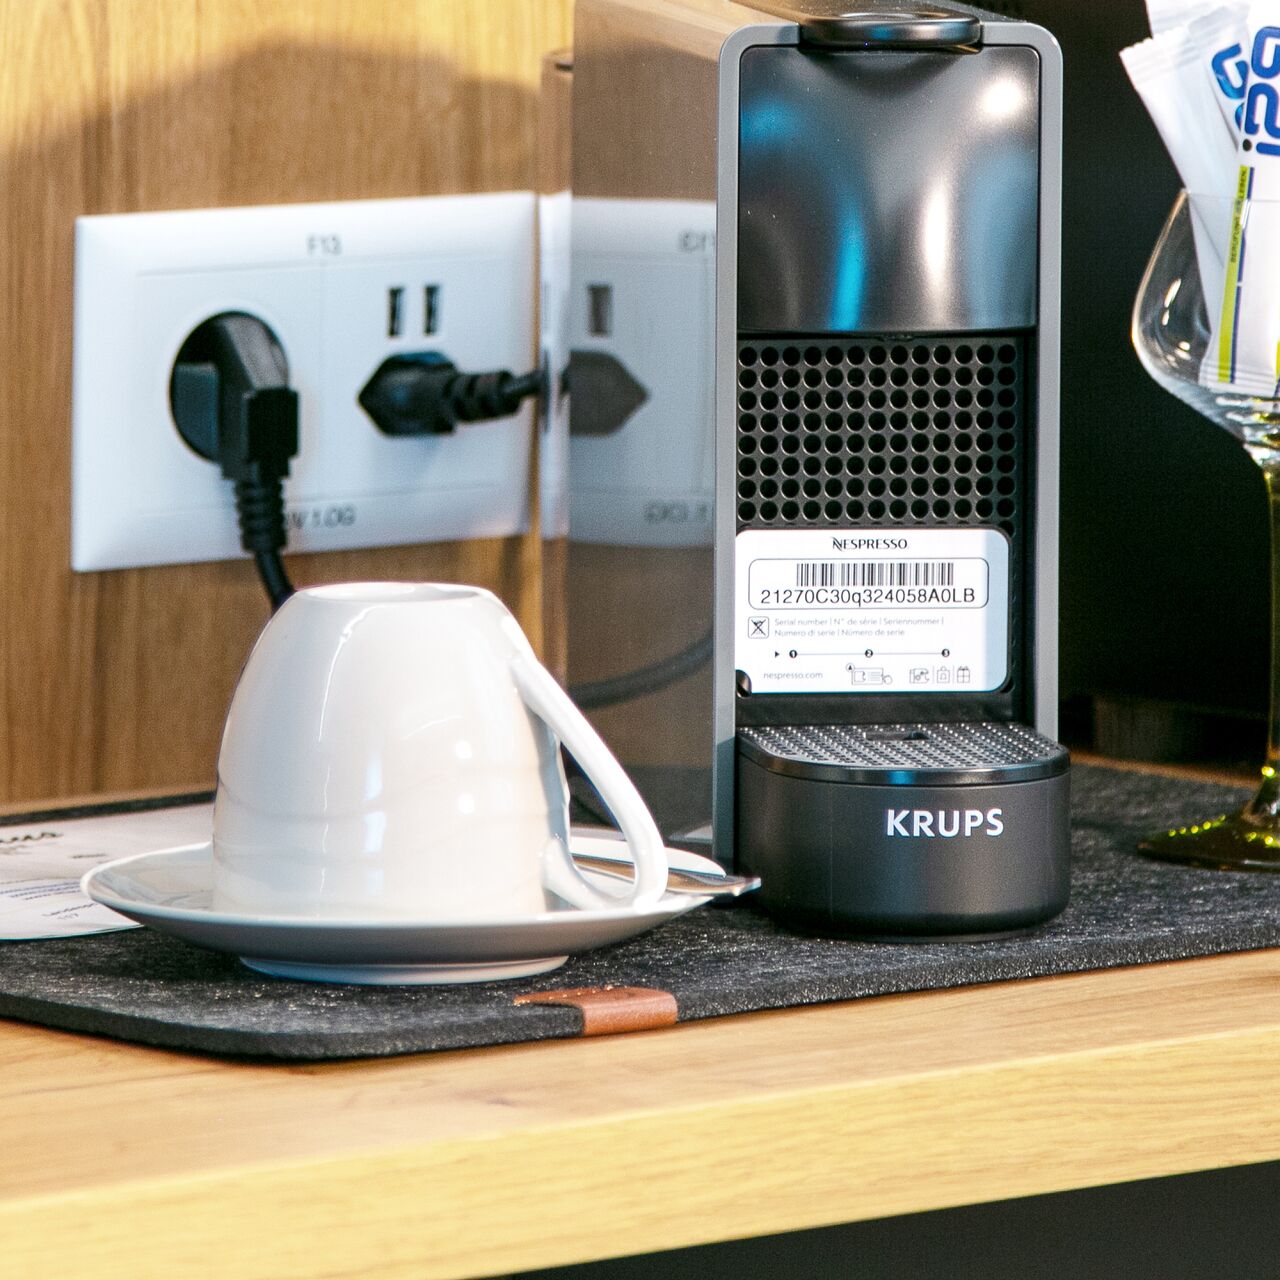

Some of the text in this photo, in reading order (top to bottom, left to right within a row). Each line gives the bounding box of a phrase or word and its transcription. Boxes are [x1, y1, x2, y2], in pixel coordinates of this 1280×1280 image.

[832, 537, 908, 551] NESPRESSO
[775, 618, 796, 626] Serial
[797, 618, 827, 626] number
[883, 616, 940, 625] Seriennummer
[775, 629, 807, 637] Numero
[808, 629, 816, 637] di
[817, 628, 836, 637] serie
[872, 628, 885, 636] de
[886, 627, 906, 636] serie
[764, 671, 823, 680] nespresso.com
[887, 808, 1004, 837] KRUPS
